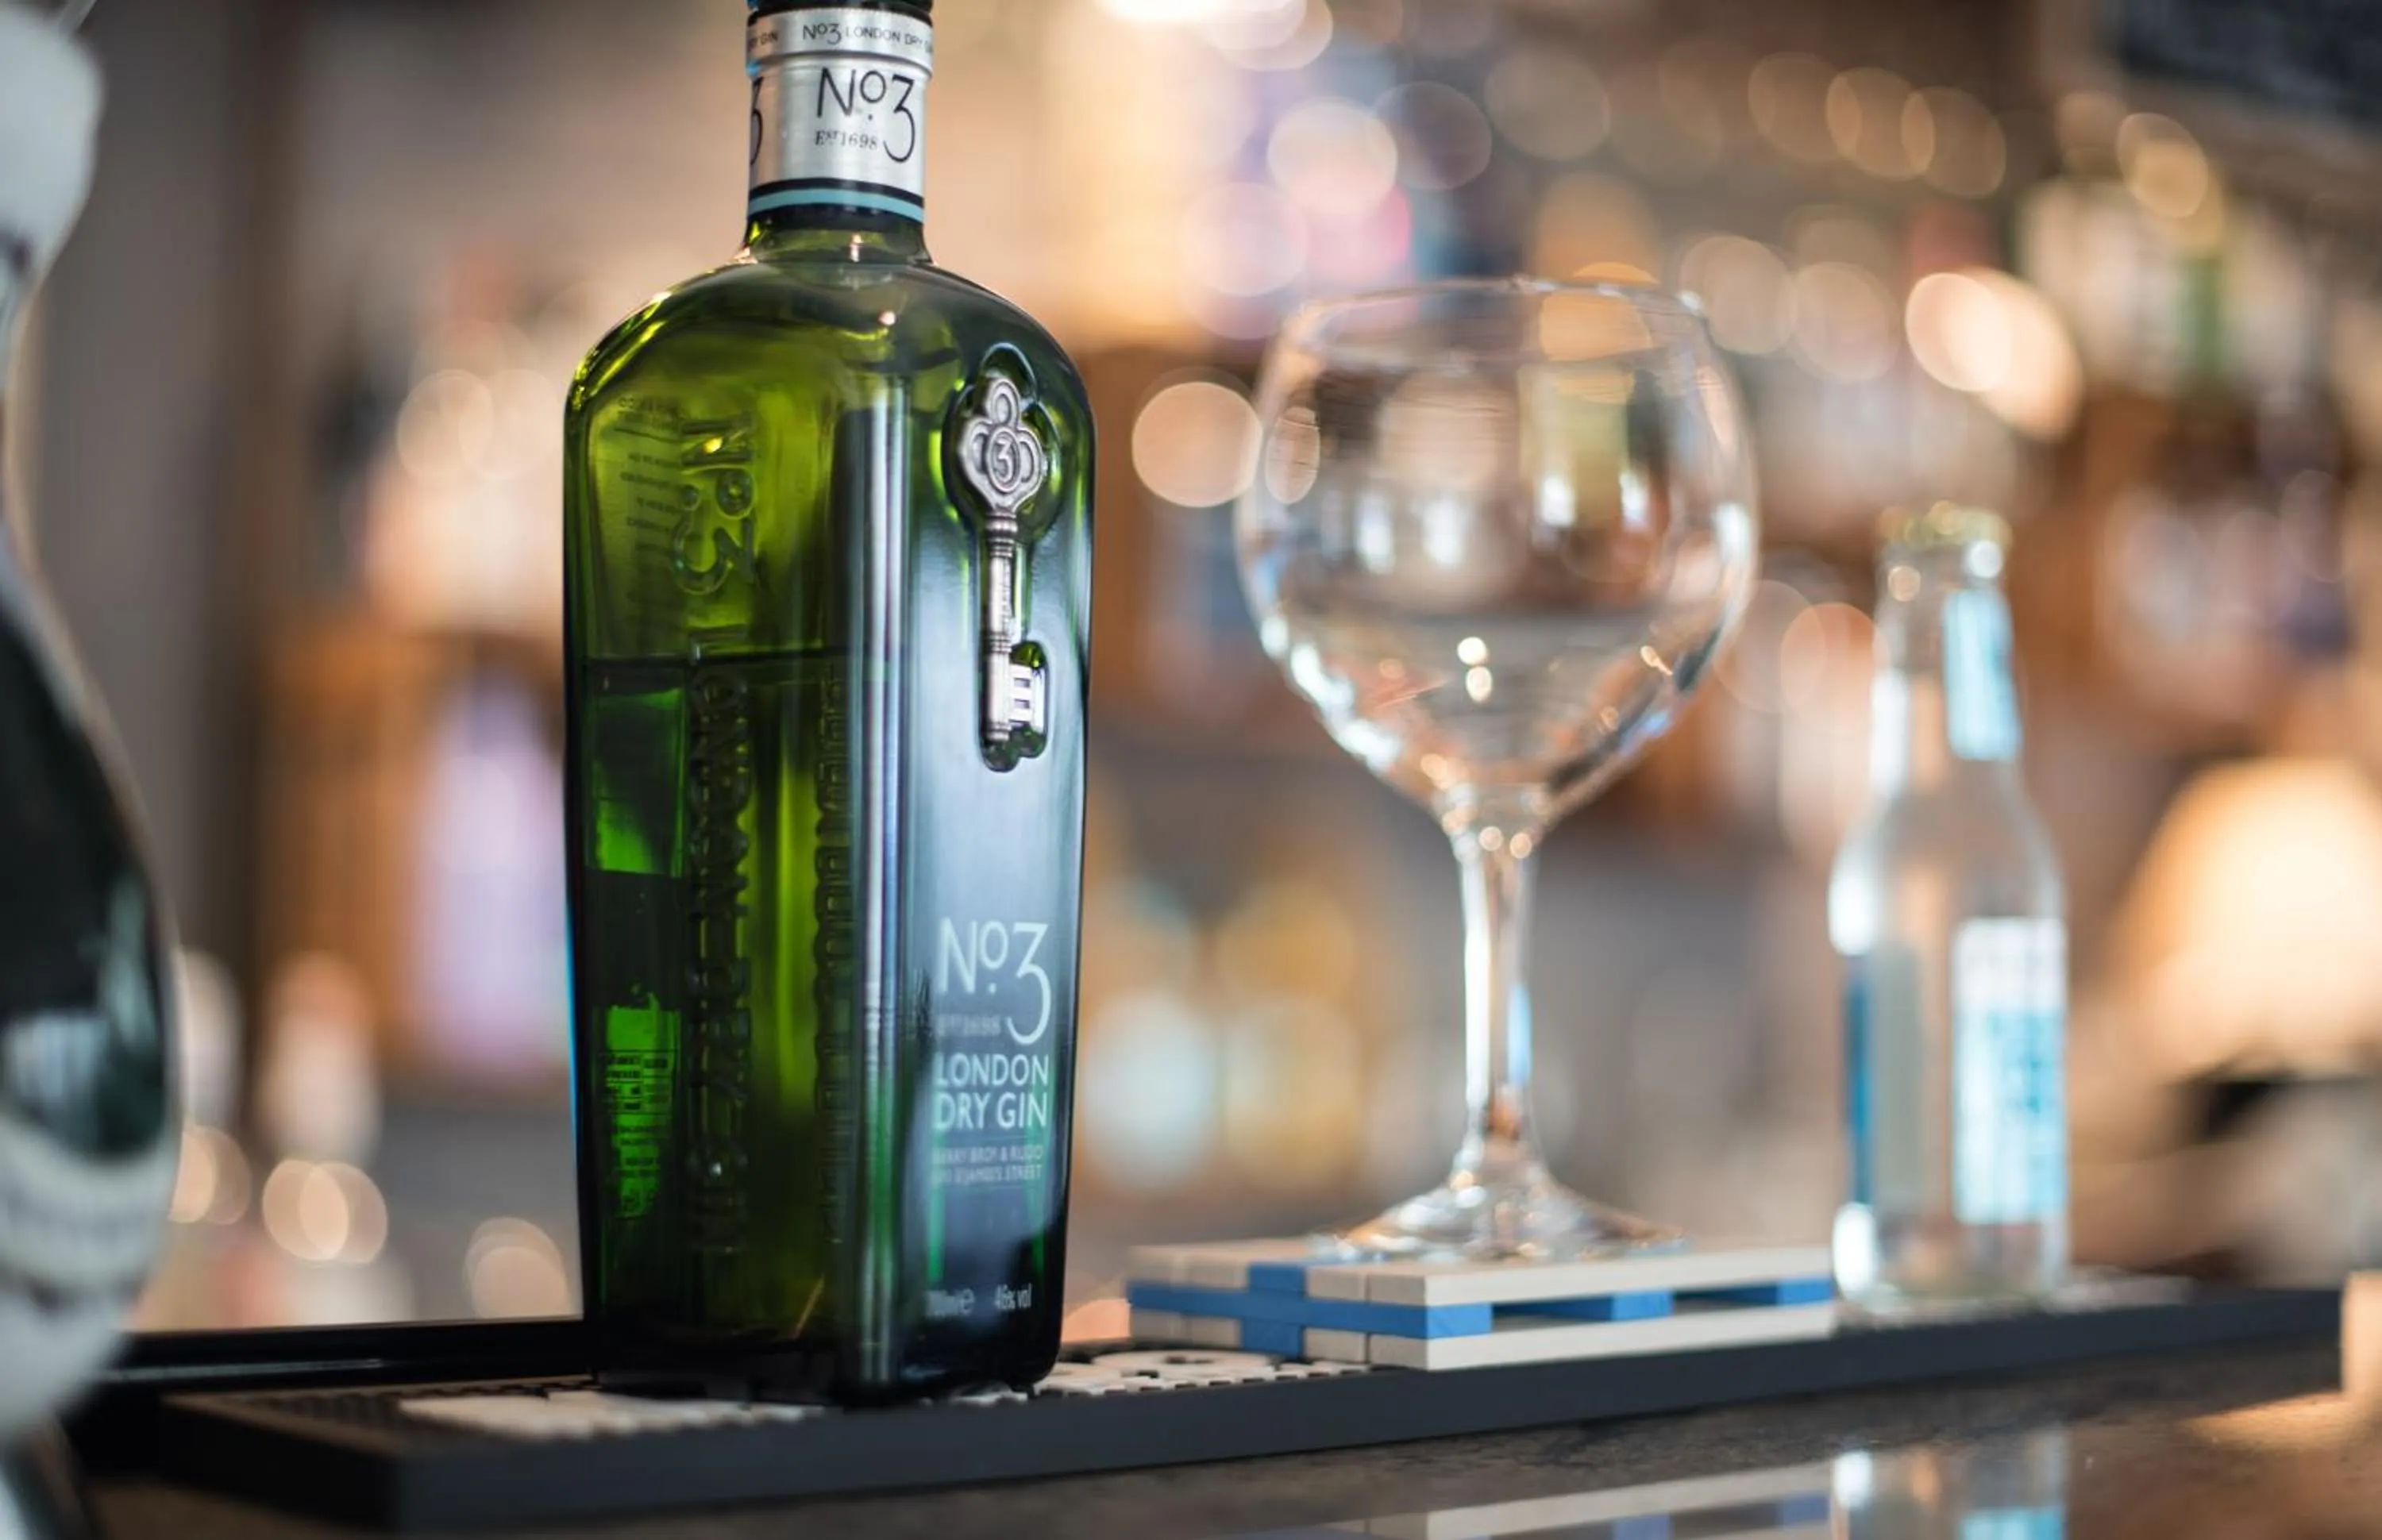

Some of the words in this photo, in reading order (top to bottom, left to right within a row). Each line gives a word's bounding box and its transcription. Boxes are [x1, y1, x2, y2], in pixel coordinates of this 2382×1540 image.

[933, 1052, 1050, 1088] LONDON
[933, 1091, 992, 1132] DRY
[996, 1091, 1048, 1130] GIN
